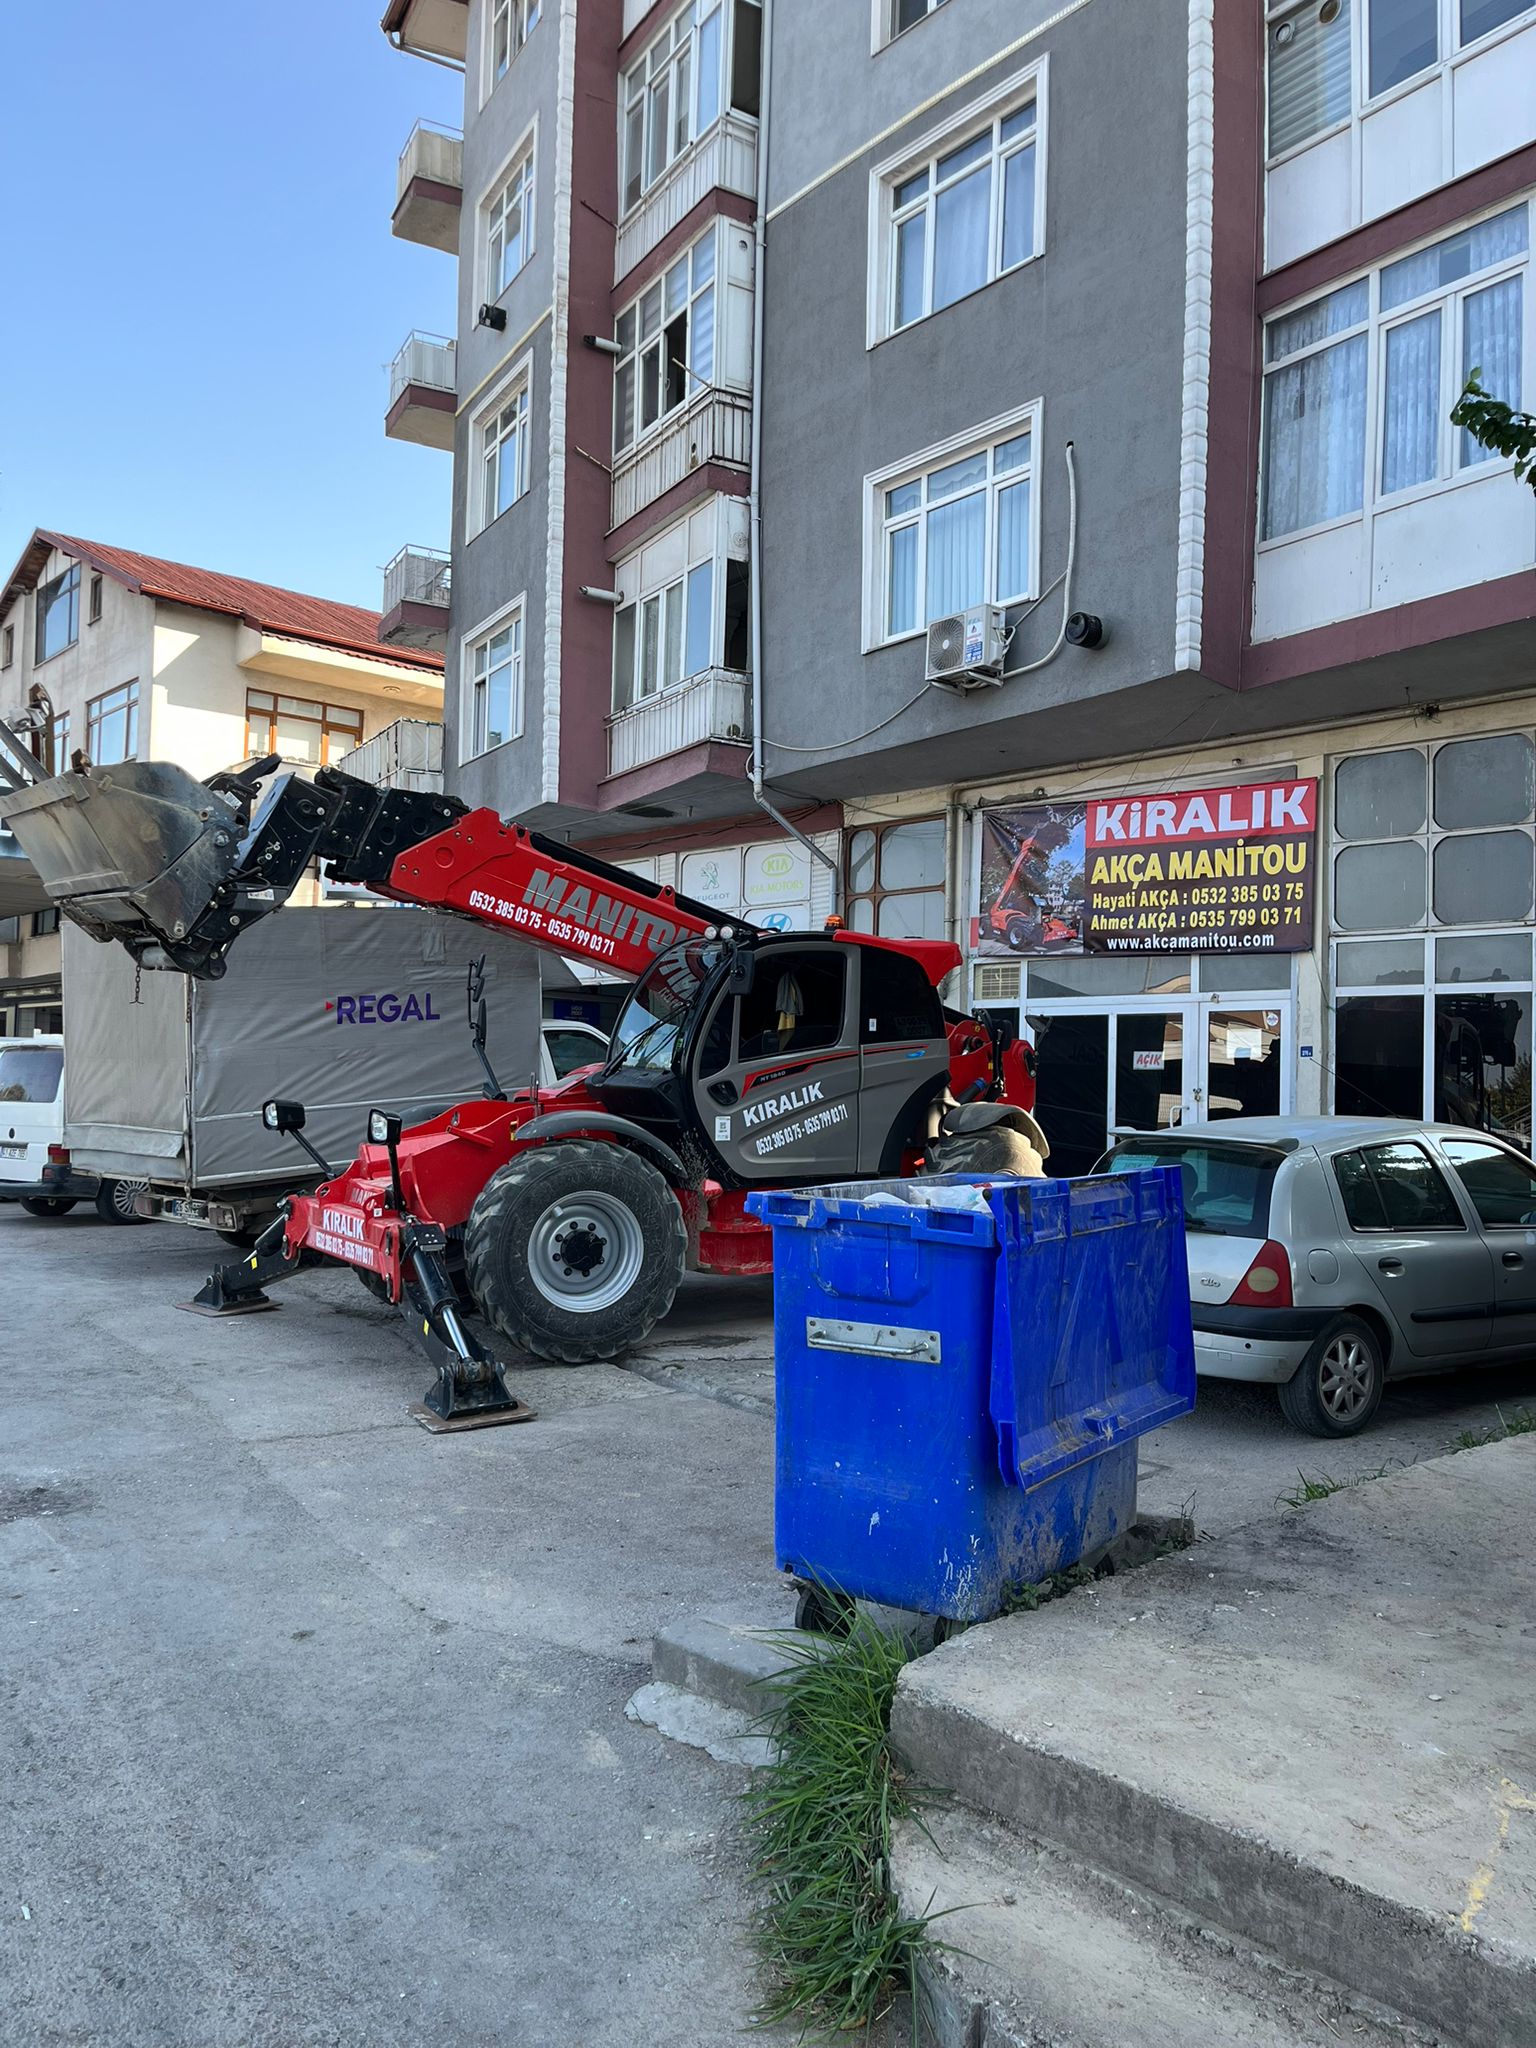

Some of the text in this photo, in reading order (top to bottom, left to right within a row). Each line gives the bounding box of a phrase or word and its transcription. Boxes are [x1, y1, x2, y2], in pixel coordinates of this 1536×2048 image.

[765, 857, 789, 872] KIA
[1091, 838, 1307, 890] AKÇA MANİTOU
[767, 879, 804, 891] MOTORS
[1092, 891, 1136, 912] Hayati
[1139, 889, 1179, 910] AKÇA
[1191, 887, 1227, 905] 0532
[1231, 885, 1258, 903] 385
[1262, 883, 1280, 901] 03
[1285, 882, 1304, 900] 75
[469, 890, 496, 914] 0532
[495, 899, 514, 920] 385
[514, 906, 529, 924] 03
[528, 912, 542, 929] 75
[547, 918, 571, 939] 0535
[571, 927, 590, 947] 799
[589, 934, 603, 951] 03
[602, 939, 615, 956] 71
[1090, 914, 1135, 930] Ahmet
[1136, 912, 1177, 932] AKÇA
[1189, 910, 1225, 928] 0535
[1229, 908, 1256, 926] 799
[1260, 907, 1279, 925] 03
[1284, 906, 1301, 924] 71
[1107, 933, 1275, 950] www.akcamanitou.com
[337, 993, 440, 1024] REGAL
[1136, 1054, 1162, 1068] AÇIK
[743, 1081, 824, 1127] KIRALIK
[756, 1135, 774, 1155] 0532
[792, 1122, 802, 1140] 75
[804, 1115, 821, 1135] 0535
[838, 1103, 848, 1120] 71
[323, 1208, 365, 1241] KIRALIK
